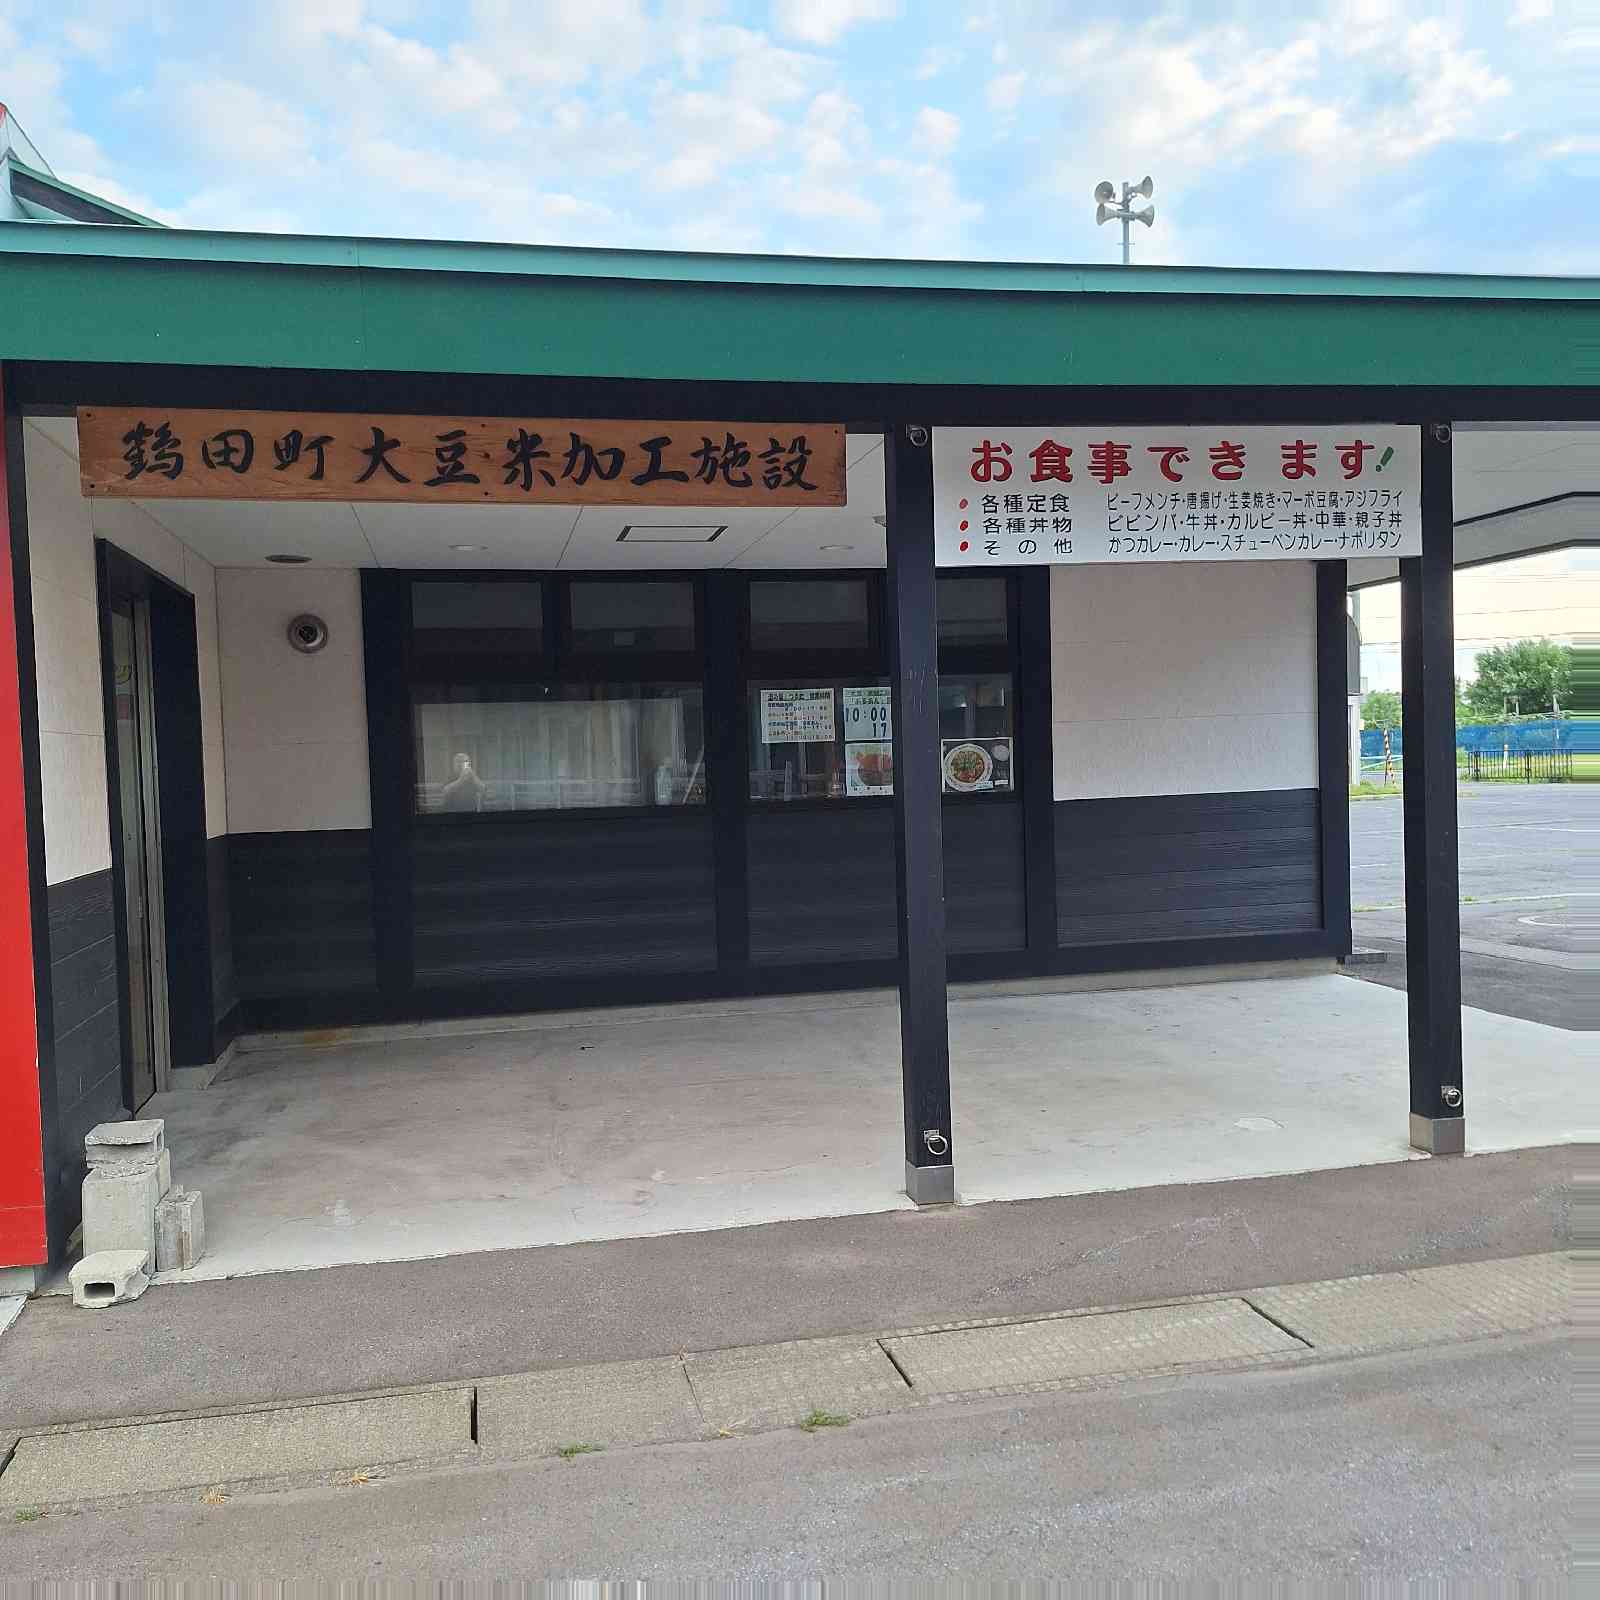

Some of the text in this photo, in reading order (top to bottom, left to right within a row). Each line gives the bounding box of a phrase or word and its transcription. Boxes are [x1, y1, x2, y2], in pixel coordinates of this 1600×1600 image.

[981, 493, 1070, 513] 各種定食
[982, 517, 1072, 534] 各種丼物
[984, 538, 1073, 555] その他
